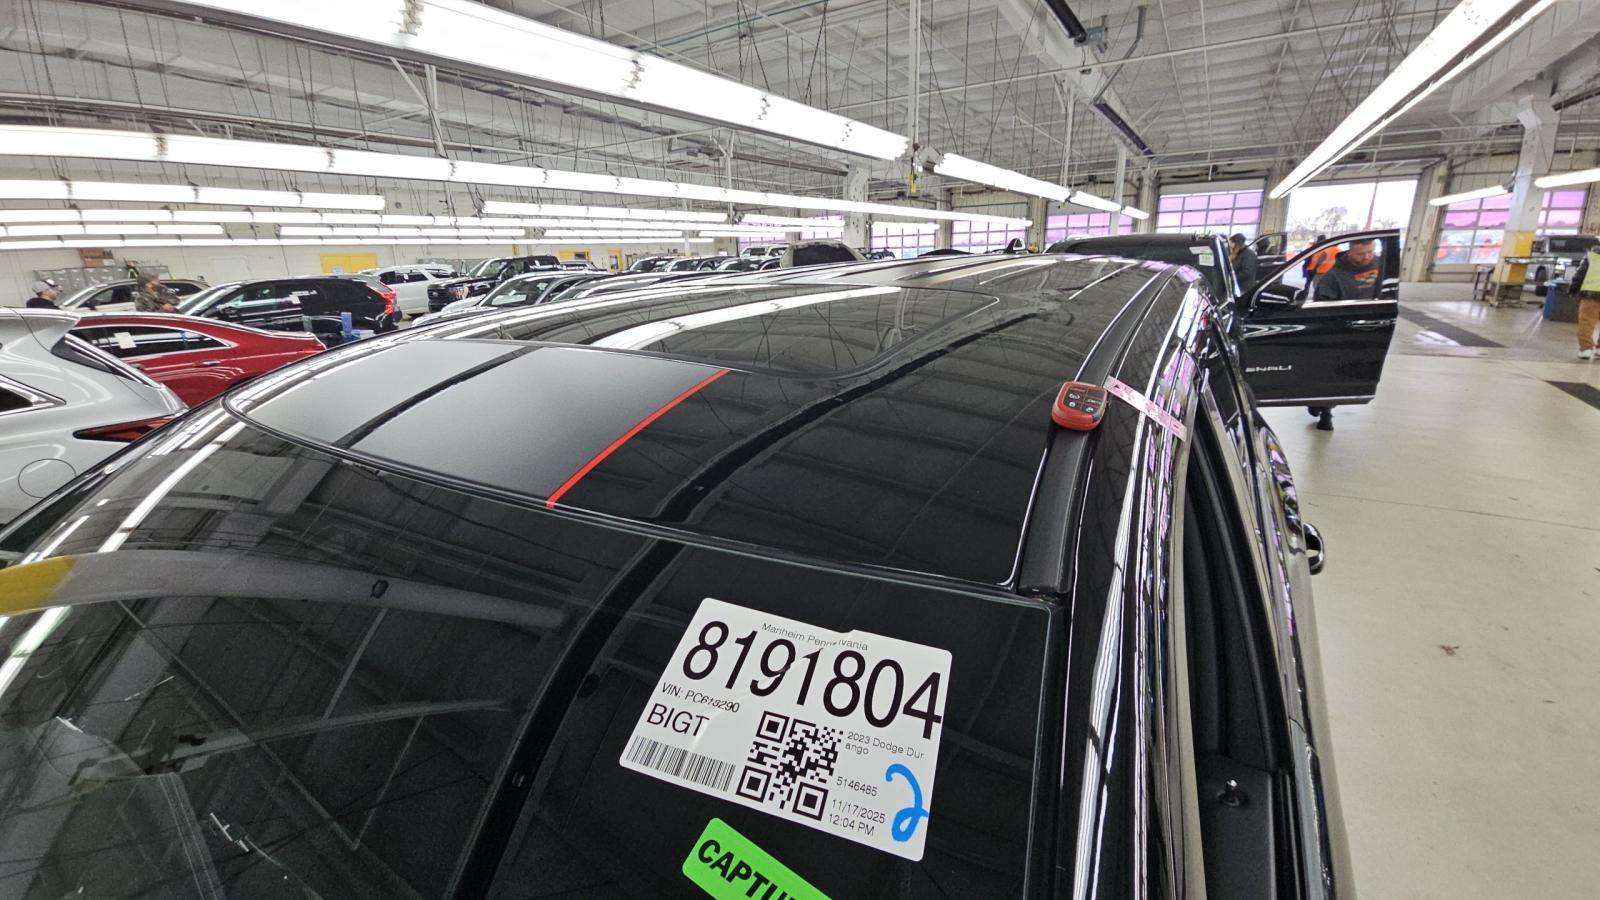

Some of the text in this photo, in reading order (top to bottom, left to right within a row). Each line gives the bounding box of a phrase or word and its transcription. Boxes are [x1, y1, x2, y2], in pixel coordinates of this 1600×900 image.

[761, 622, 805, 641] Manheim
[661, 682, 681, 698] VIN:
[682, 620, 942, 740] 8191804
[646, 702, 710, 736] BIGT
[845, 742, 869, 755] ango
[847, 731, 925, 759] 2023 Dodge Dur
[836, 776, 878, 797] 5146485
[832, 799, 886, 824] 11/17/2025
[829, 813, 875, 836] 12:04 PM
